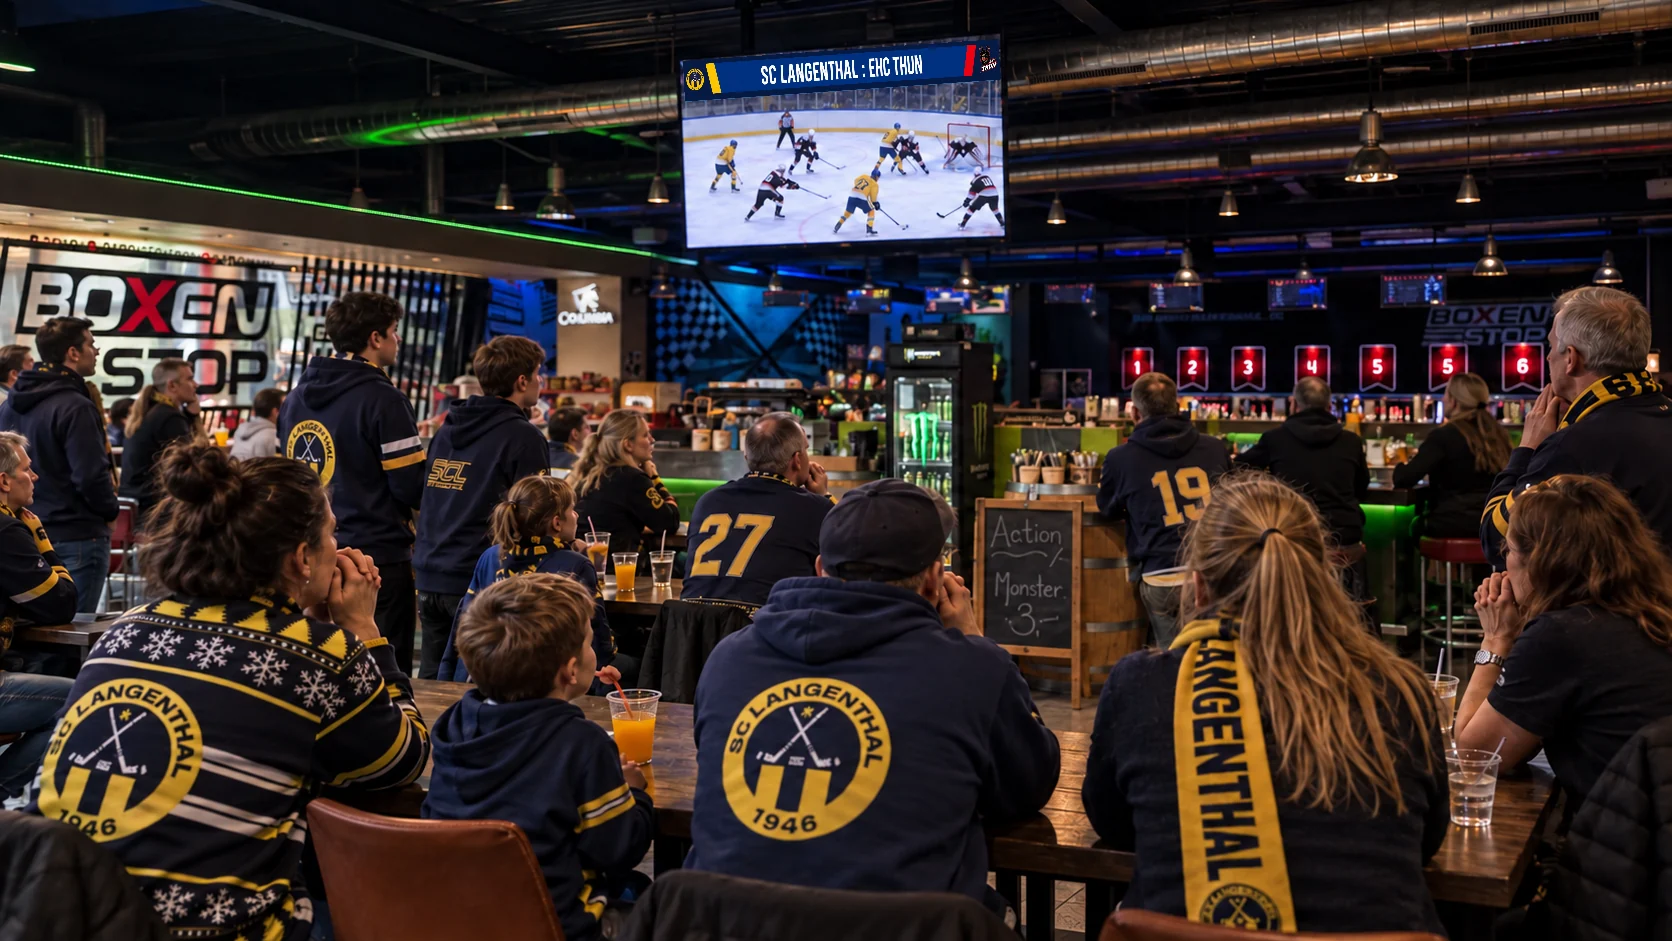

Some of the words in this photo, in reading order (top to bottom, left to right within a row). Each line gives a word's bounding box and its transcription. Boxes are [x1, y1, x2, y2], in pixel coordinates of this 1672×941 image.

[760, 65, 777, 85] SC
[780, 59, 859, 84] LANGENTHAL
[861, 64, 865, 78] :
[868, 57, 890, 78] EHC
[892, 54, 923, 76] THUN
[22, 269, 269, 336] BOXEN
[1430, 306, 1547, 325] BOXEN
[1465, 327, 1547, 346] STOP
[1133, 361, 1141, 375] 1
[1187, 360, 1198, 375] 2
[1243, 360, 1254, 375] 3
[1306, 360, 1317, 374] 4
[1372, 359, 1384, 374] 5
[1442, 359, 1454, 374] 5
[1516, 358, 1529, 374] 6
[1151, 466, 1212, 528] 19
[990, 516, 1063, 548] Action
[690, 512, 776, 578] 27
[50, 720, 72, 755] SC
[76, 684, 195, 778] LANGENTHAL
[729, 720, 751, 754] SC
[750, 683, 883, 768] LANGENTHAL
[60, 808, 117, 837] 1946
[752, 808, 818, 834] 1946
